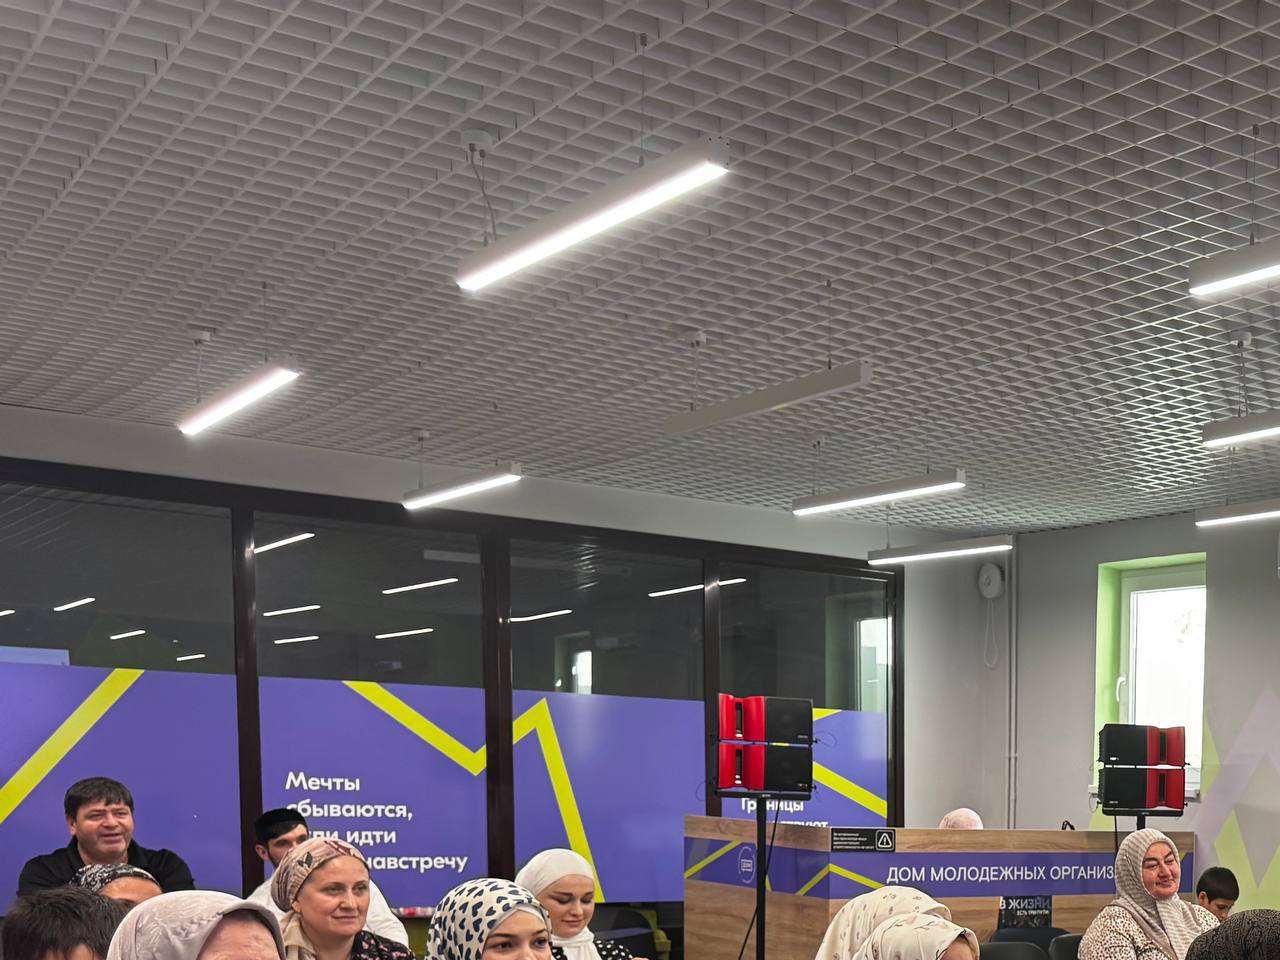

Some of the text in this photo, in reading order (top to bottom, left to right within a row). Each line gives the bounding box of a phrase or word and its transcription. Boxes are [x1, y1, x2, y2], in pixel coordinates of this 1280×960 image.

[285, 771, 360, 791] Мечты
[741, 797, 804, 813] Грницы
[346, 830, 397, 846] идти
[887, 865, 1115, 883] ДОМ МОЛОДЕЖНЫХ ОРГАНИЗ
[1008, 897, 1050, 910] ЖИЗНИ
